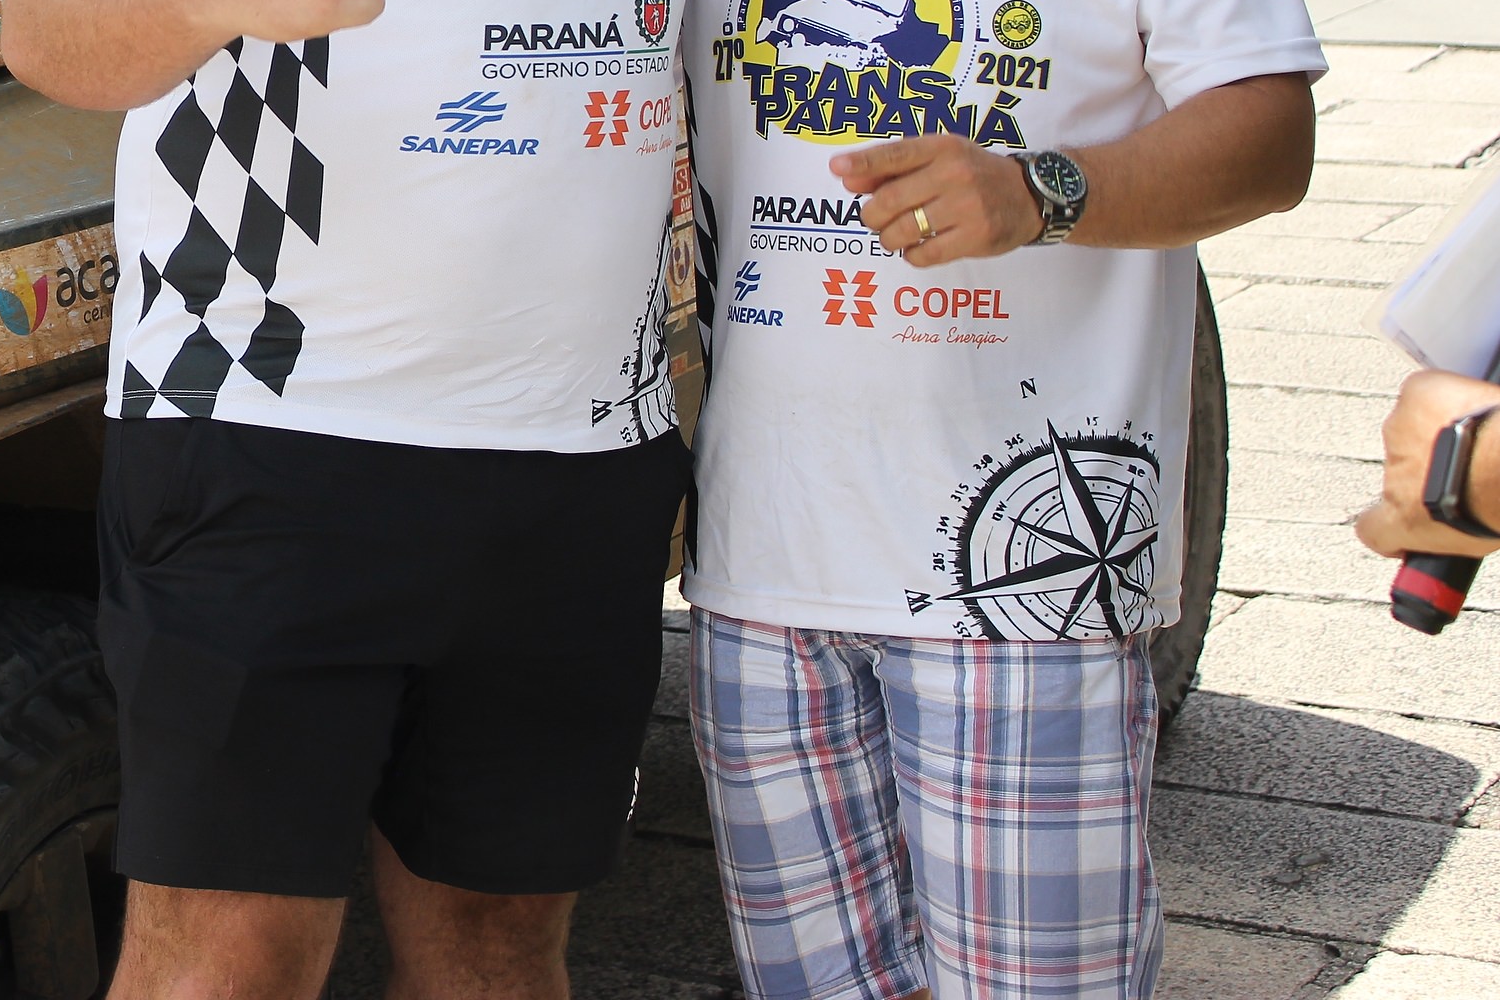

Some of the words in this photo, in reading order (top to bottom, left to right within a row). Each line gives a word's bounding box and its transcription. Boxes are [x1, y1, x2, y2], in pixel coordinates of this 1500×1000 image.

[484, 13, 624, 51] PARANÁ
[482, 61, 589, 80] GOVERNO
[595, 59, 622, 76] DO
[626, 55, 670, 75] ESTADO
[742, 61, 958, 103] TRANS
[976, 52, 1051, 91] 2021
[639, 96, 672, 130] COPE
[752, 90, 1028, 150] PARANÁ
[399, 135, 540, 155] SANEPAR
[752, 194, 866, 226] PARANÁ
[750, 233, 828, 251] GOVERNO
[834, 238, 863, 255] DO
[727, 304, 784, 327] SANEPAR
[893, 285, 1010, 319] COPEL
[1019, 377, 1038, 399] N
[591, 398, 612, 428] W
[1003, 432, 1025, 450] 345
[1085, 416, 1099, 426] 15
[950, 482, 969, 503] 315
[904, 588, 932, 617] W
